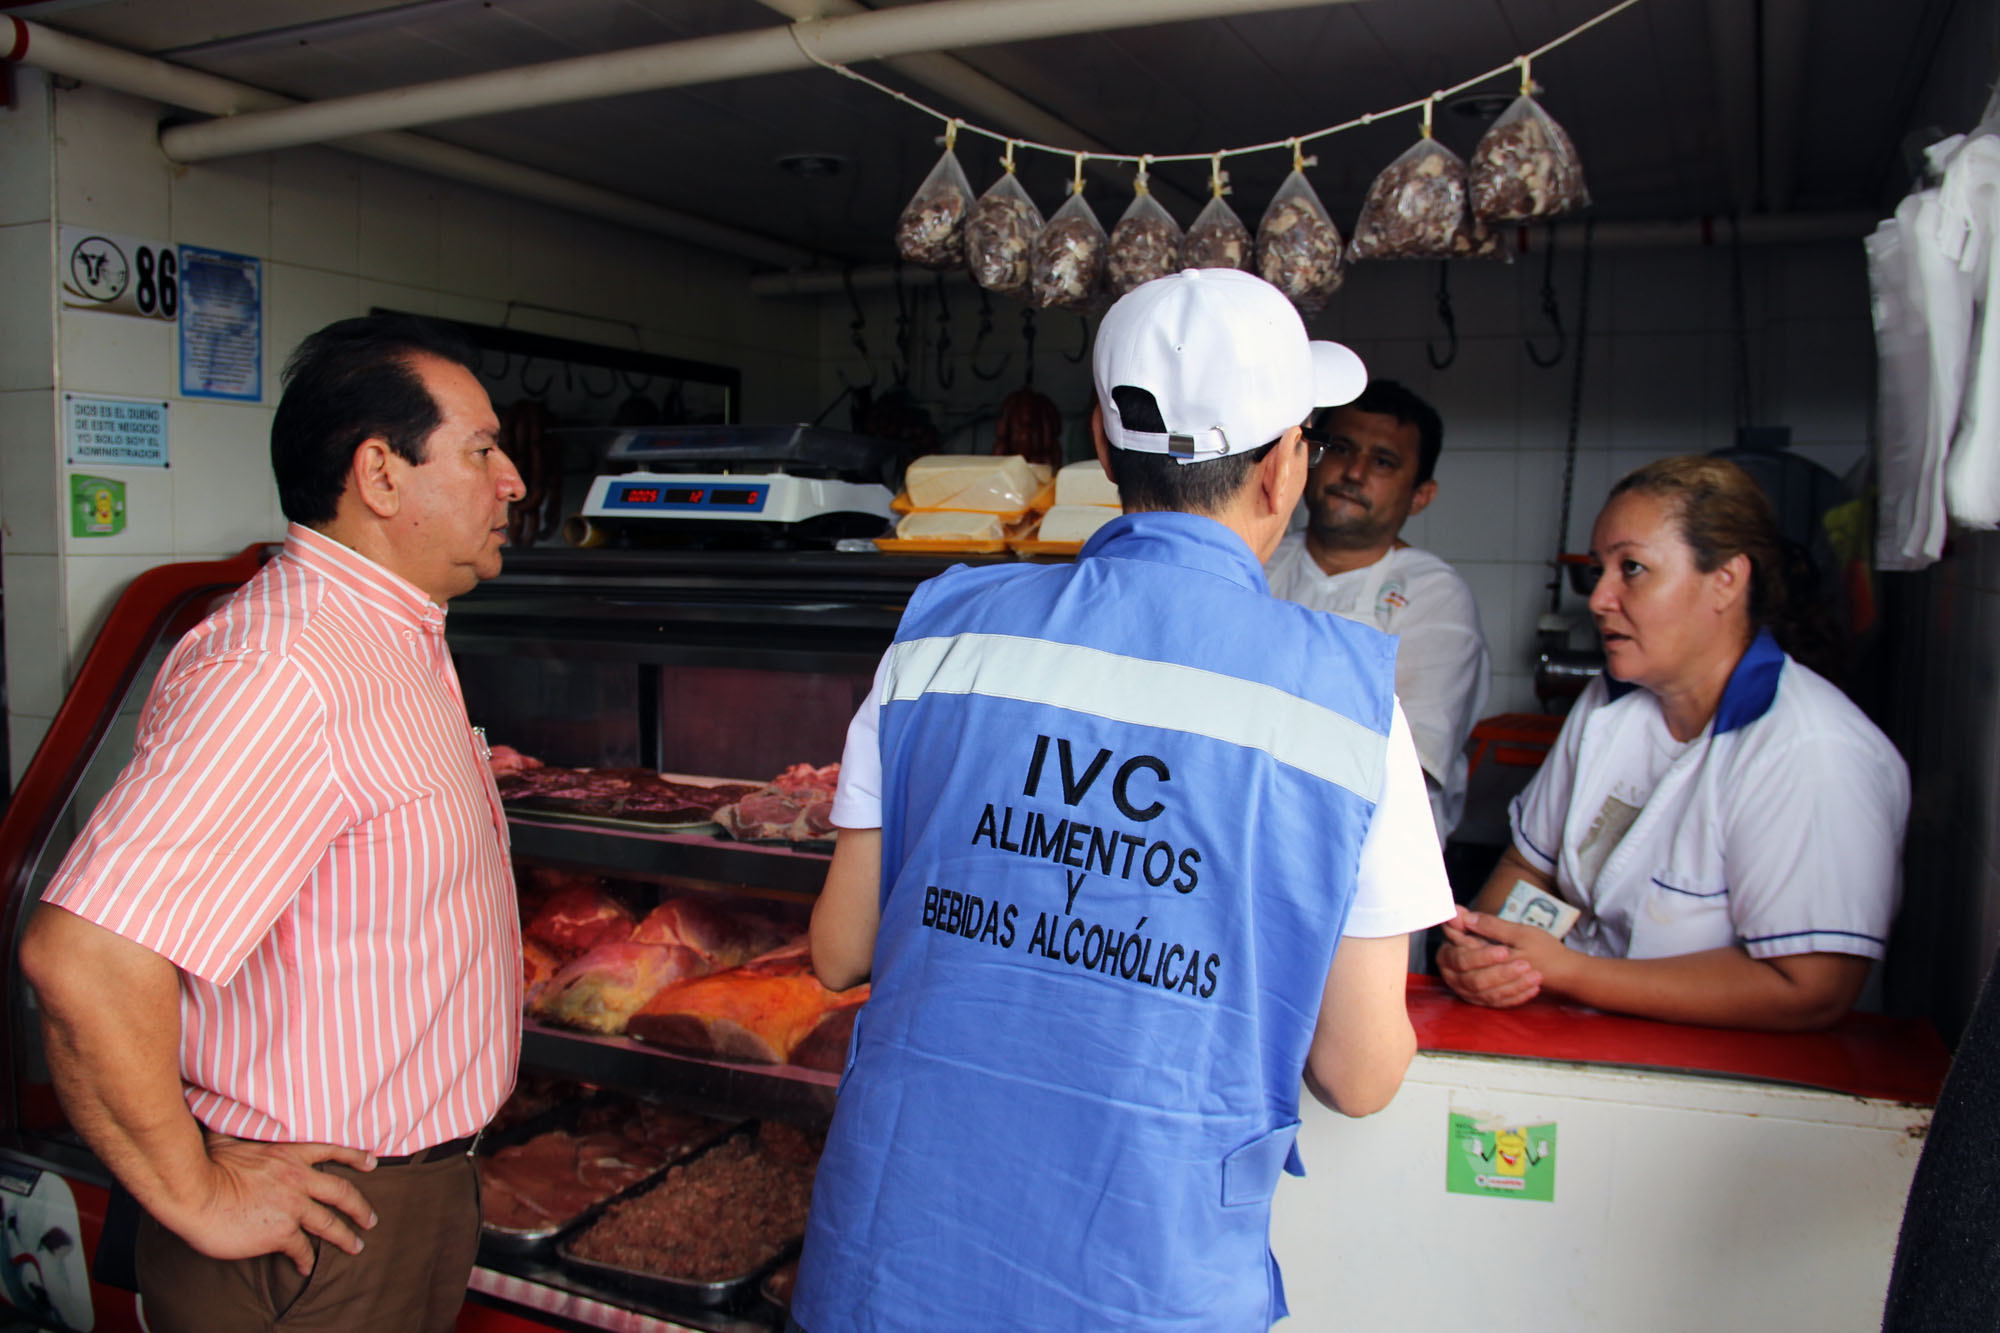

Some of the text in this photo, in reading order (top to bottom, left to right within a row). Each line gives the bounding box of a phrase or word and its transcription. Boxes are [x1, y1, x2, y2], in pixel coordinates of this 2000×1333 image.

[136, 246, 177, 317] 86
[74, 403, 160, 420] DIOS ES EL DUEÑO
[75, 418, 161, 434] DE ESTE NEGOCIO
[77, 432, 160, 448] YO SOLO SOY EL
[78, 445, 161, 459] ADMINISTRADOR
[1023, 734, 1171, 822] IVC
[971, 803, 1202, 894] ALIMENTOS
[1065, 869, 1087, 915] Y
[922, 886, 1221, 998] BEBIDAS ALCOHÓLICAS
